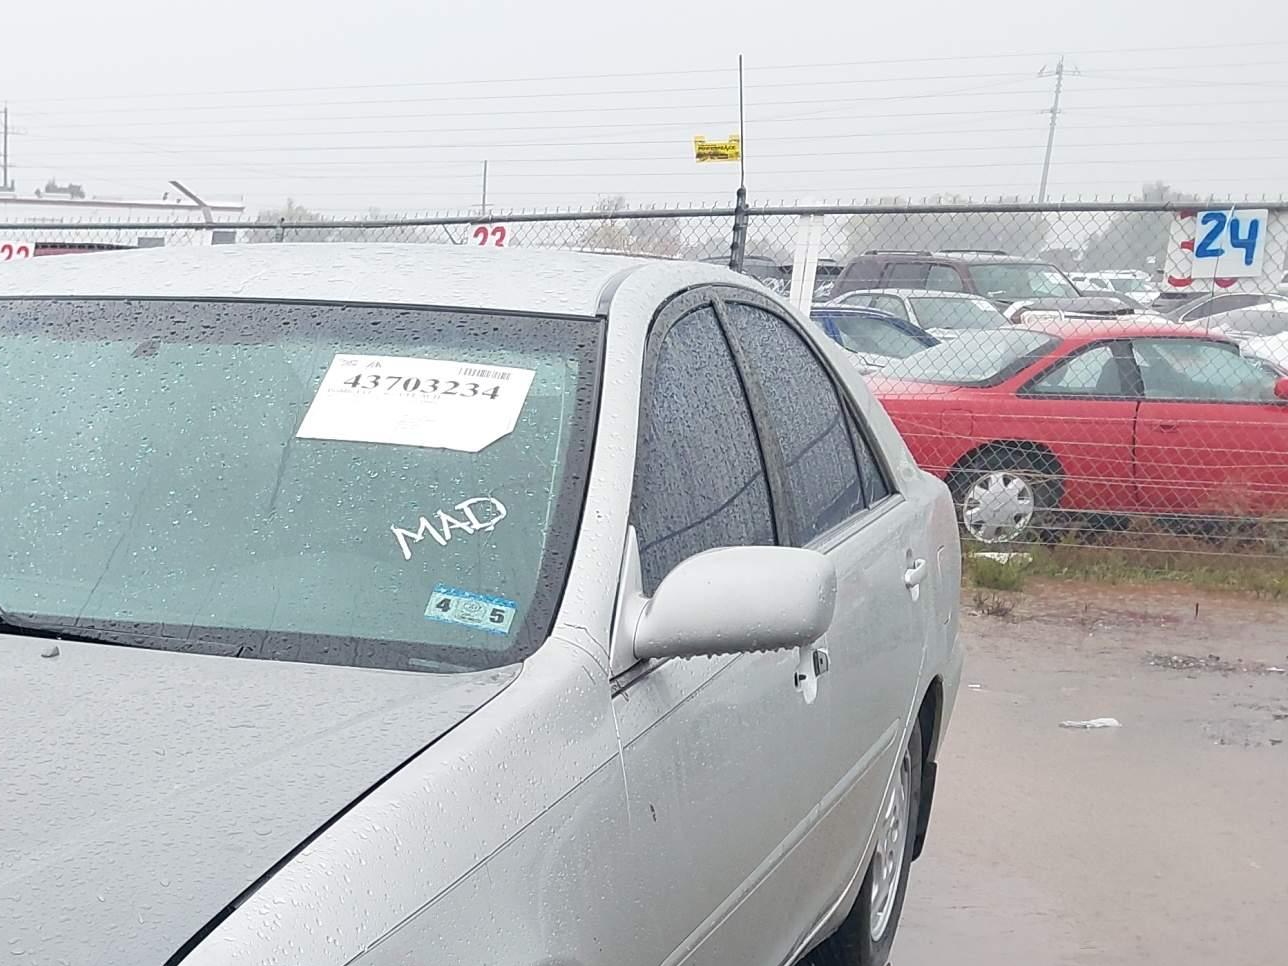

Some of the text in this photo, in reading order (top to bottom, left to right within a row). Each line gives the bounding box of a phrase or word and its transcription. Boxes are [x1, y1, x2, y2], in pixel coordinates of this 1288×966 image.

[1195, 212, 1259, 266] 24
[343, 373, 501, 400] 43703234
[391, 497, 507, 560] MAD
[435, 598, 451, 613] 4
[489, 608, 505, 623] 5
